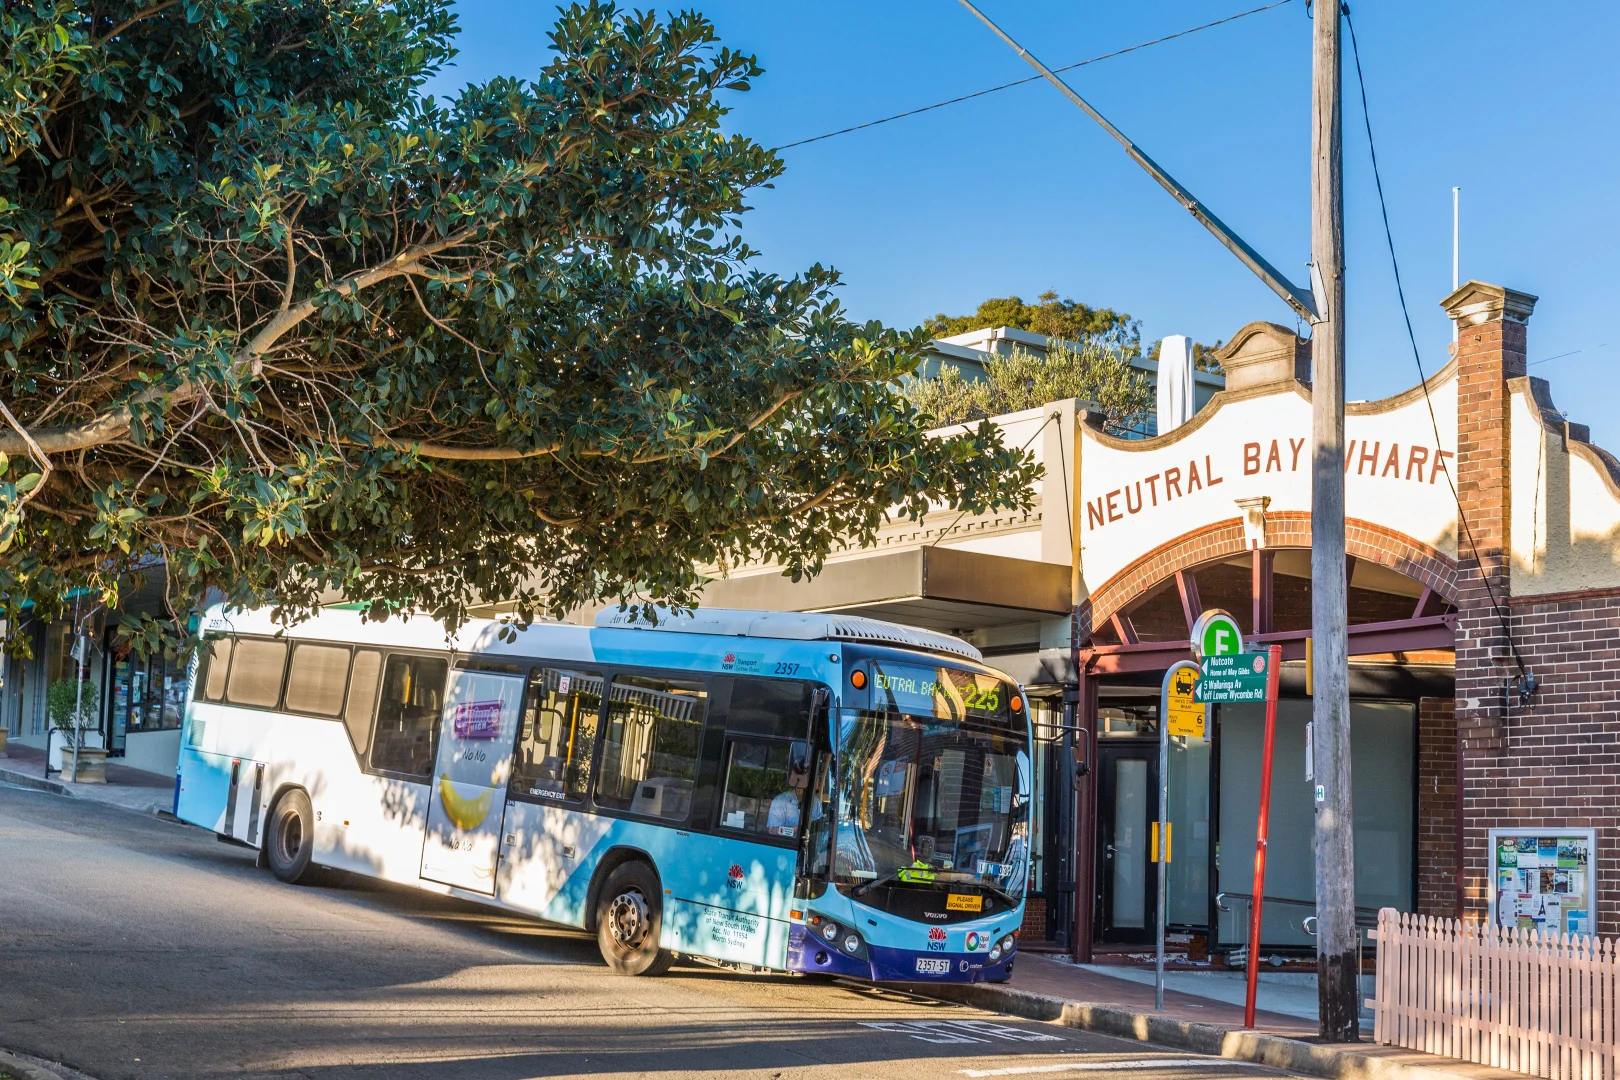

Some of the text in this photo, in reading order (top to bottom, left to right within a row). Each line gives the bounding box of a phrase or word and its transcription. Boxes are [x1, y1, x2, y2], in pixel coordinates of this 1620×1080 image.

[1087, 455, 1223, 531] NEUTRAL
[1244, 438, 1305, 475] BAY
[209, 619, 223, 629] 2357
[610, 613, 623, 624] Air
[722, 663, 734, 671] NSW
[738, 658, 757, 666] Transport
[1211, 657, 1234, 667] Nutcote
[774, 662, 800, 675] 2357
[1228, 668, 1237, 676] May
[1203, 679, 1242, 691] 5 Wallaringa Av
[964, 683, 1000, 711] 225
[1213, 691, 1228, 700] Lower
[1229, 689, 1253, 701] Wycombe
[1197, 715, 1203, 724] 6
[462, 748, 486, 762] No No
[529, 787, 566, 800] EMERGENCY EXIT
[449, 839, 473, 851] Na Na
[726, 879, 743, 890] NSW
[704, 908, 759, 928] State Transit Authority
[724, 920, 740, 930] South
[741, 924, 756, 934] Wales
[722, 928, 731, 936] No.
[733, 930, 748, 940] 11954
[980, 935, 990, 943] Opal
[712, 933, 746, 949] North Sydney
[927, 941, 947, 951] NSW
[856, 1020, 1067, 1044] BUS
